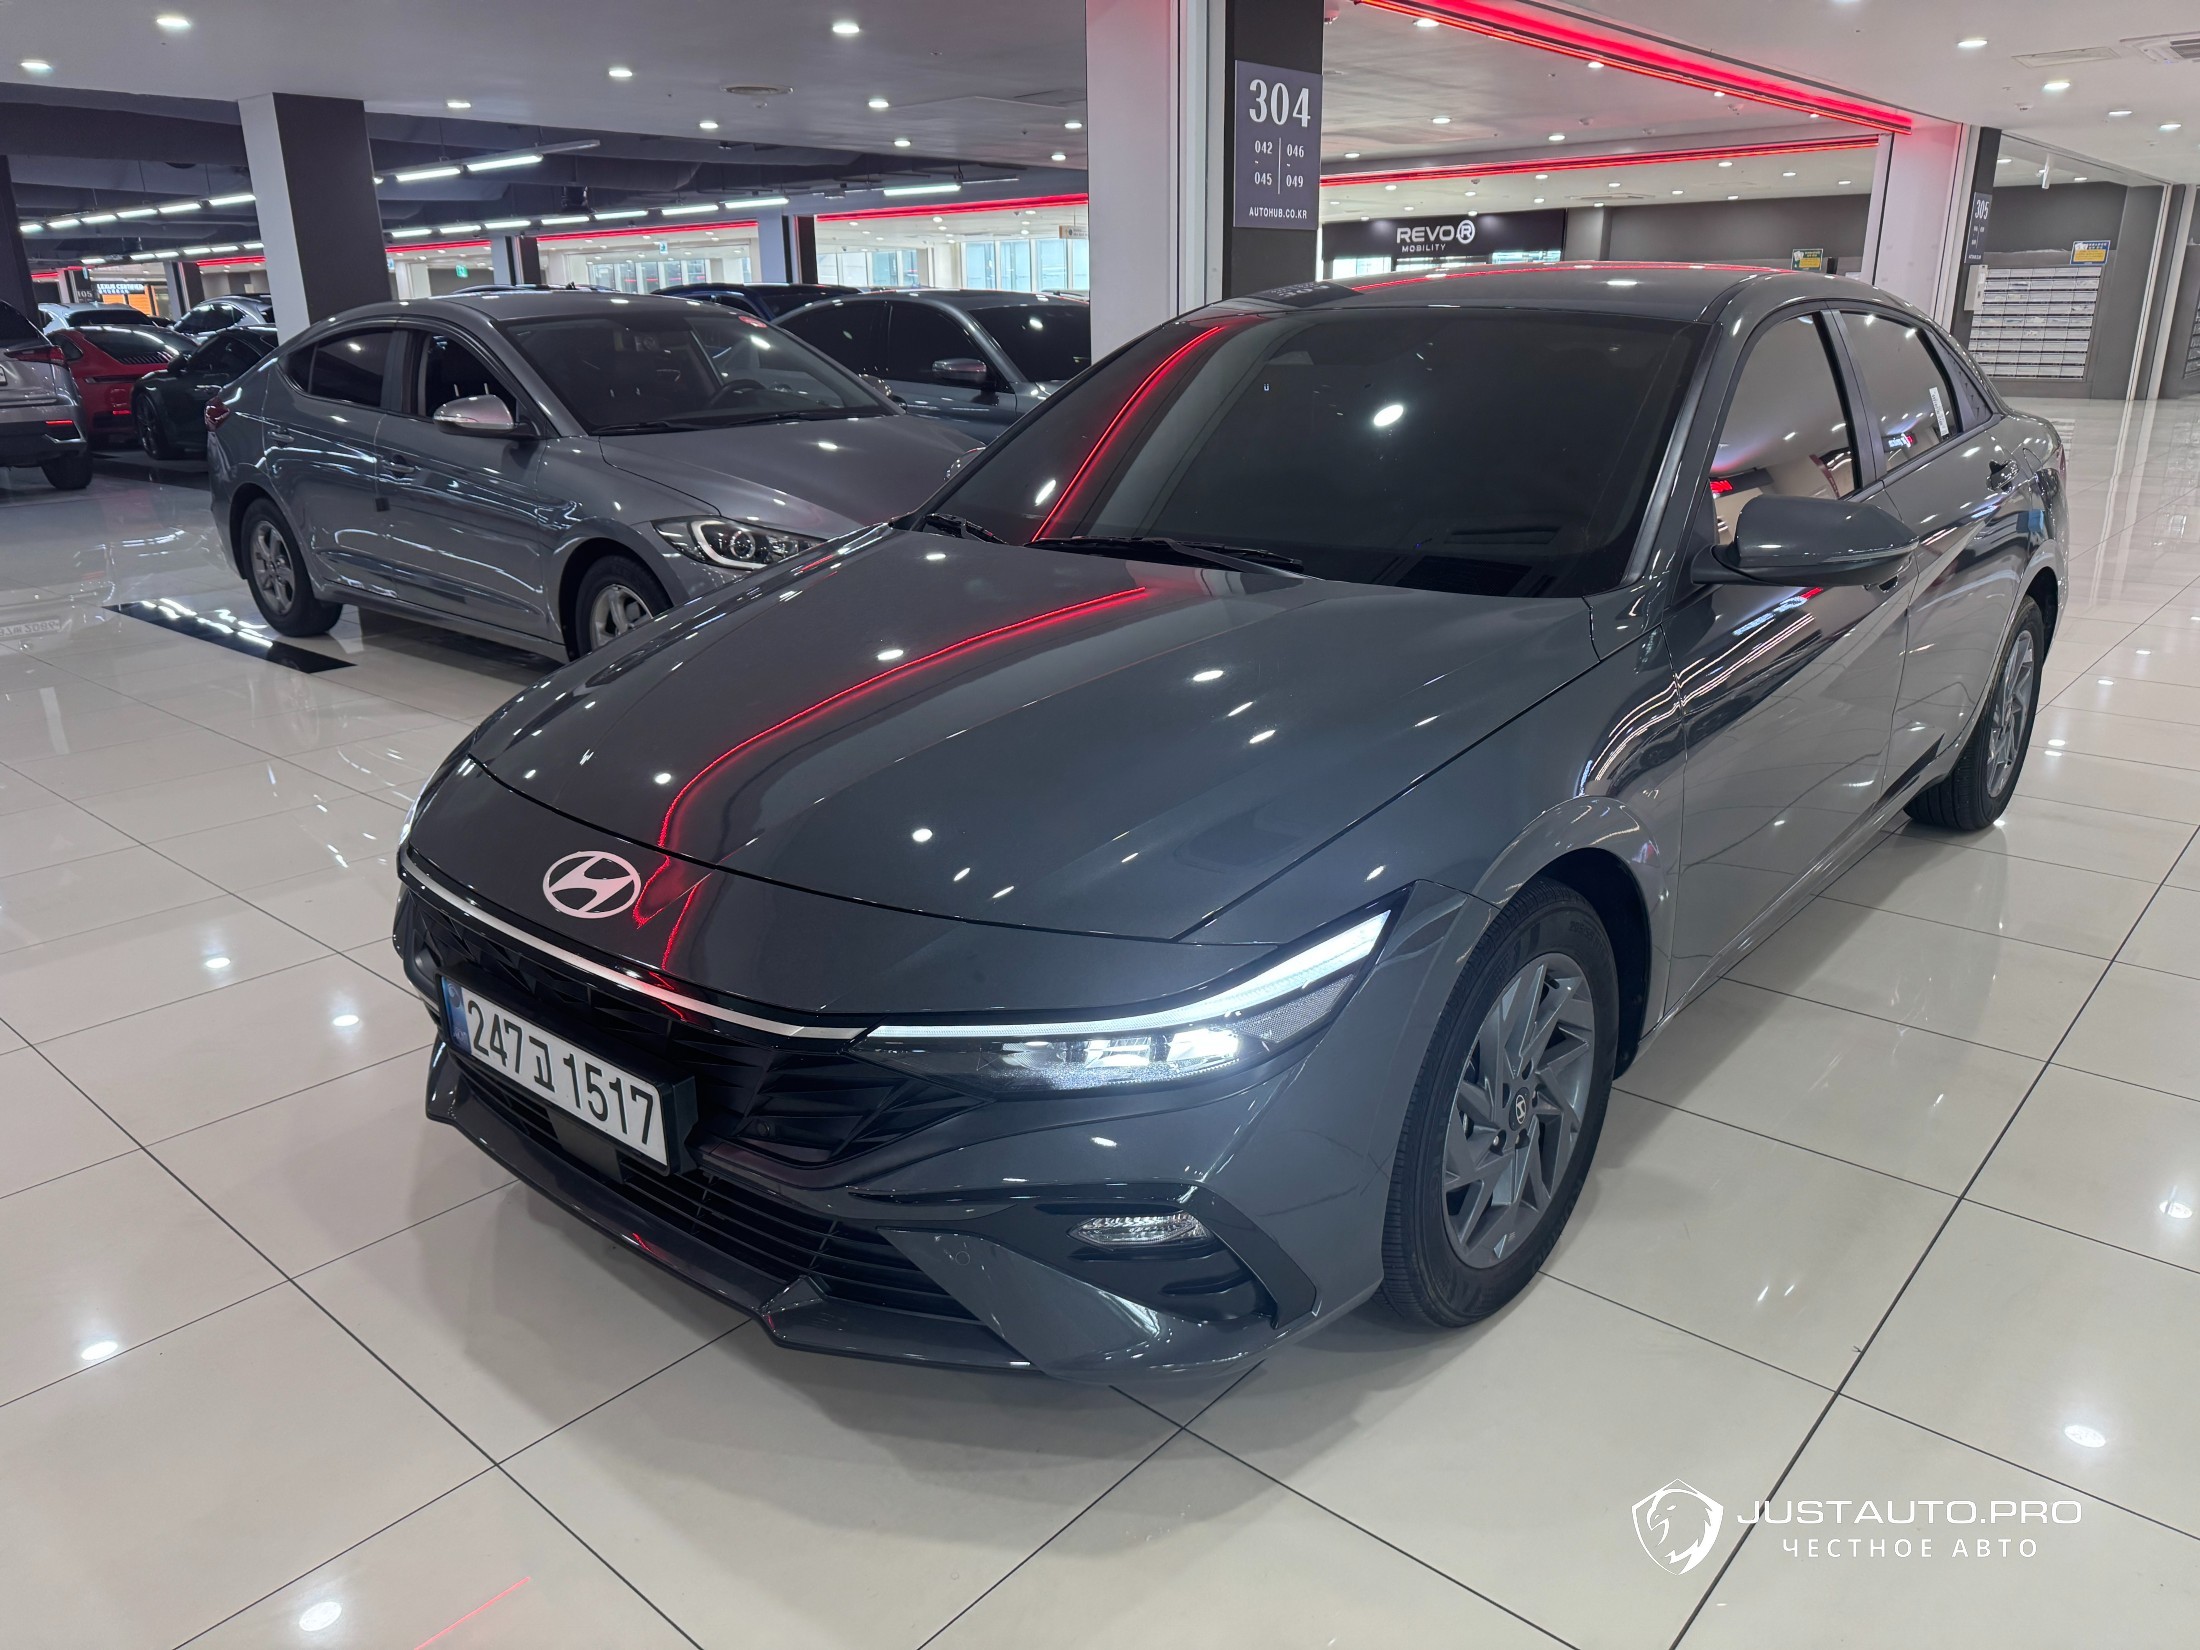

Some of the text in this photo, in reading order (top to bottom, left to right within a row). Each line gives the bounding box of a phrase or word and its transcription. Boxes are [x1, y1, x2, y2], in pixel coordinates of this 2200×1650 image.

[1249, 79, 1311, 128] 304
[1254, 140, 1273, 154] 042
[1286, 143, 1305, 158] 046
[1254, 171, 1273, 186] 045
[1286, 174, 1304, 188] 049
[1249, 206, 1308, 219] AUTOHUB.CO.KR
[1974, 199, 1990, 220] 305
[1401, 243, 1447, 253] MOBILITY
[77, 290, 93, 298] 105
